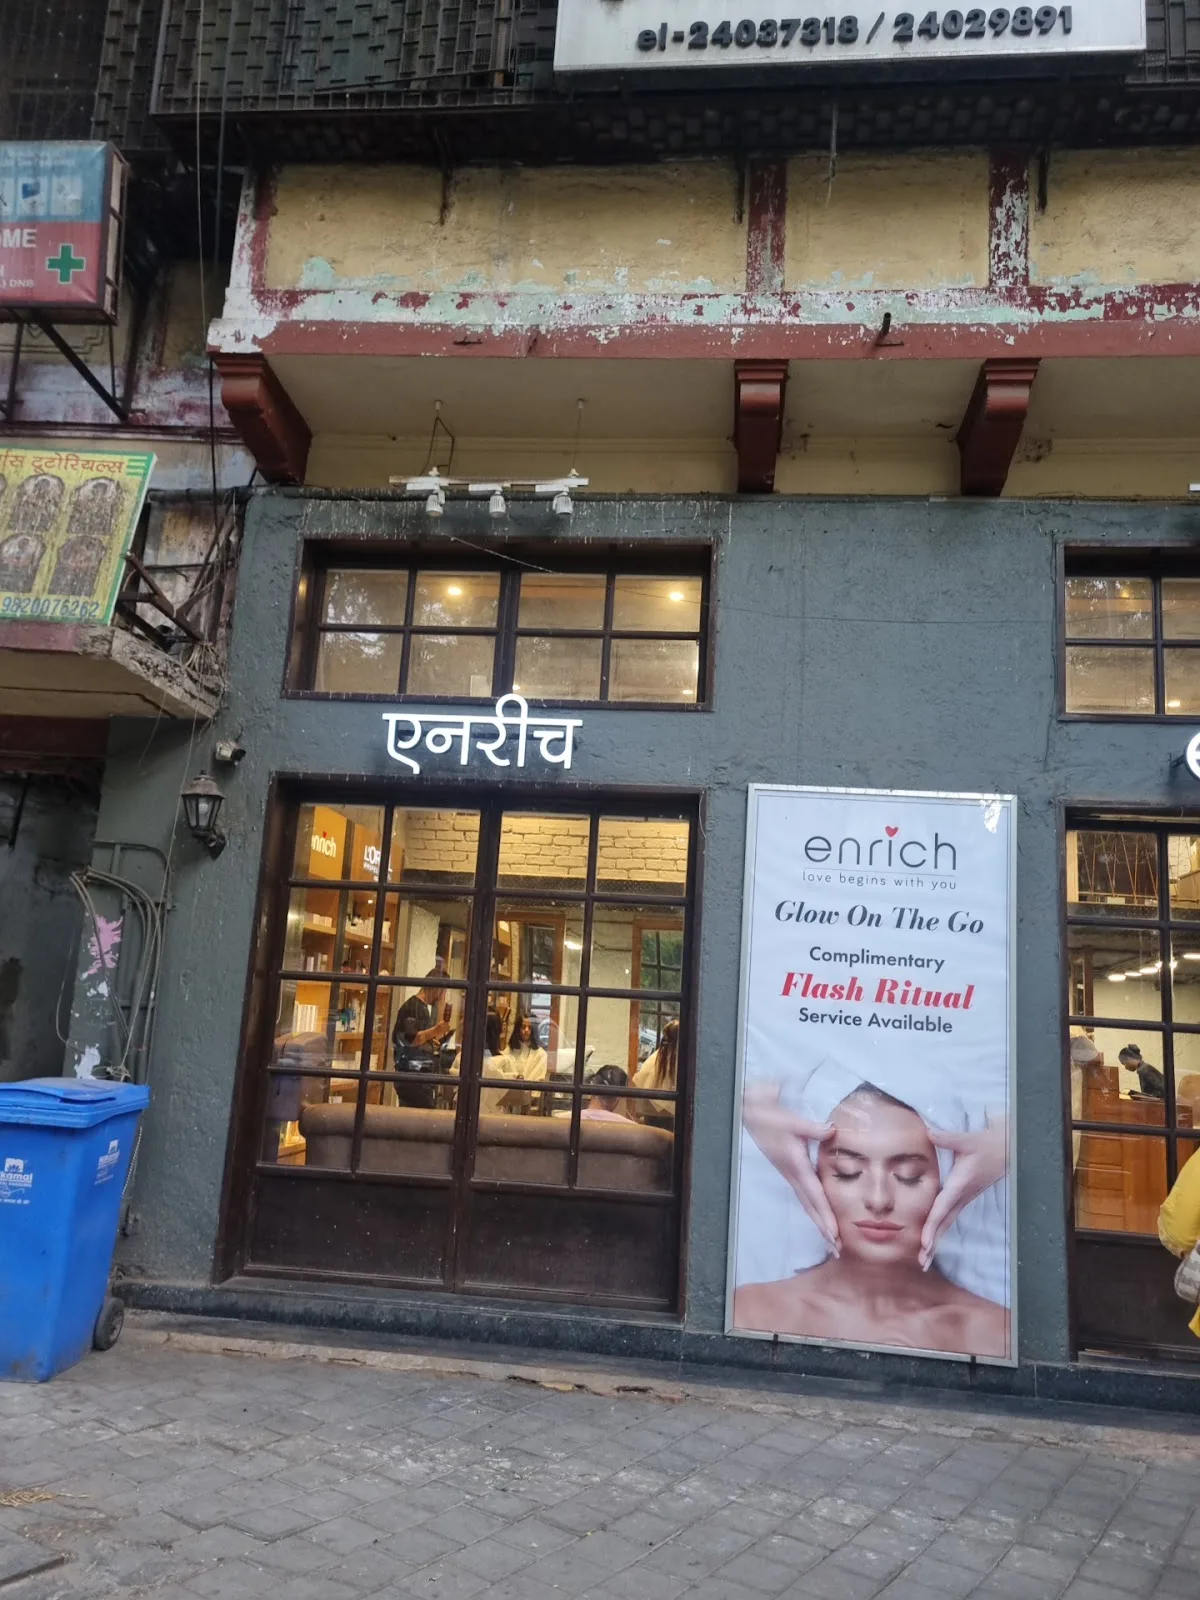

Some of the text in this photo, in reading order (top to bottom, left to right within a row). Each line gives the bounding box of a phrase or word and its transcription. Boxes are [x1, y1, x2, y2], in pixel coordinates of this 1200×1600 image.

[892, 5, 1073, 43] 24029891
[1, 596, 99, 618] 9820076262
[381, 693, 584, 775] एनरीच
[311, 831, 336, 858] nrich
[804, 826, 957, 870] enrich
[803, 870, 957, 891] love begins with you
[774, 900, 984, 934] Glow On The Go
[809, 946, 945, 973] Complimentary
[779, 972, 975, 1010] Flash Ritual
[798, 1007, 953, 1033] Service Available
